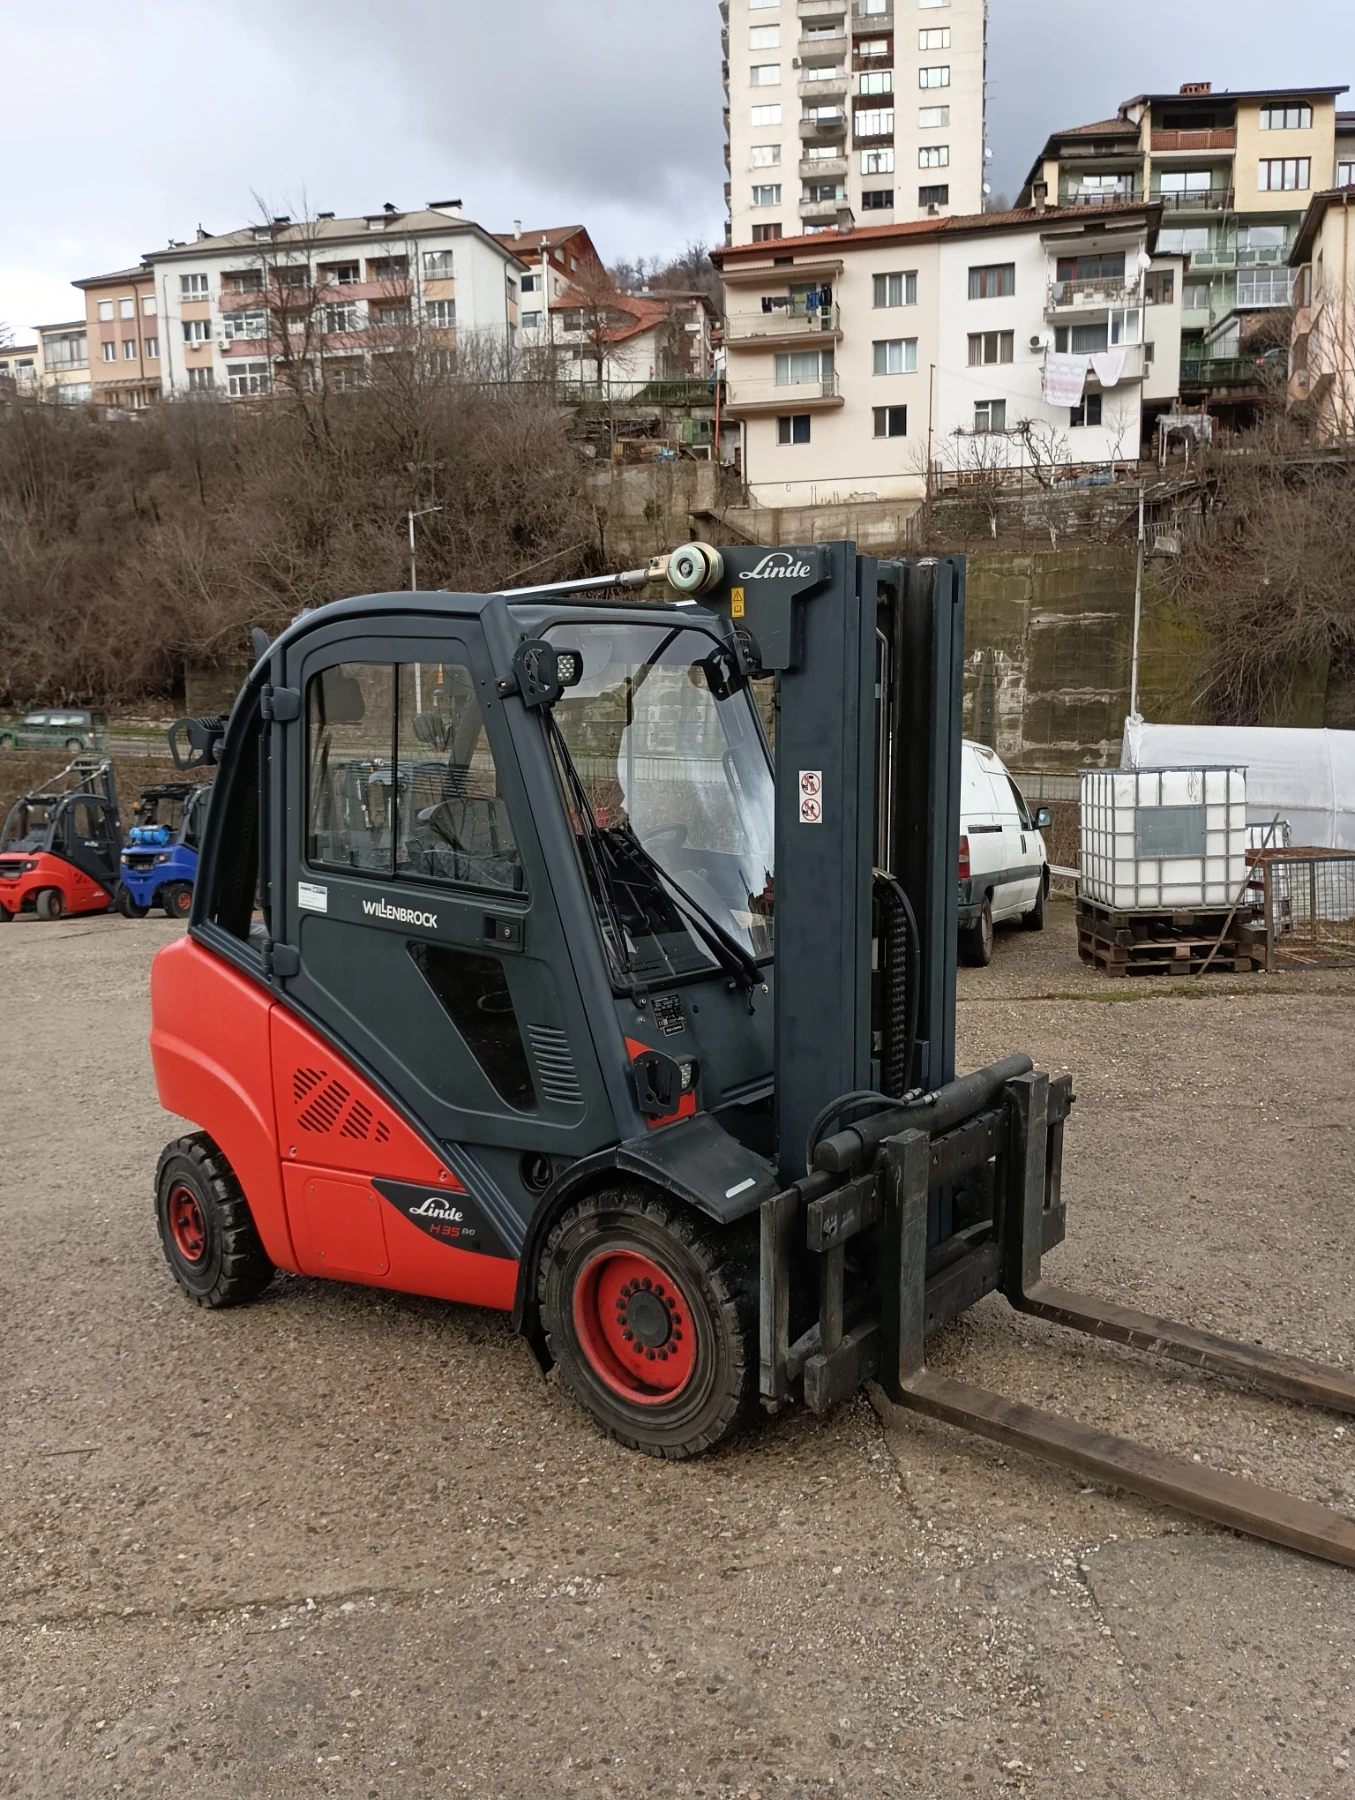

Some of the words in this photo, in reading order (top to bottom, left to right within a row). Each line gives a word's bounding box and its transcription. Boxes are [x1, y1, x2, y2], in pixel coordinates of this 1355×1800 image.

[738, 552, 811, 580] Linde
[362, 897, 438, 929] WILLENBROCK
[409, 1197, 463, 1221] Linde
